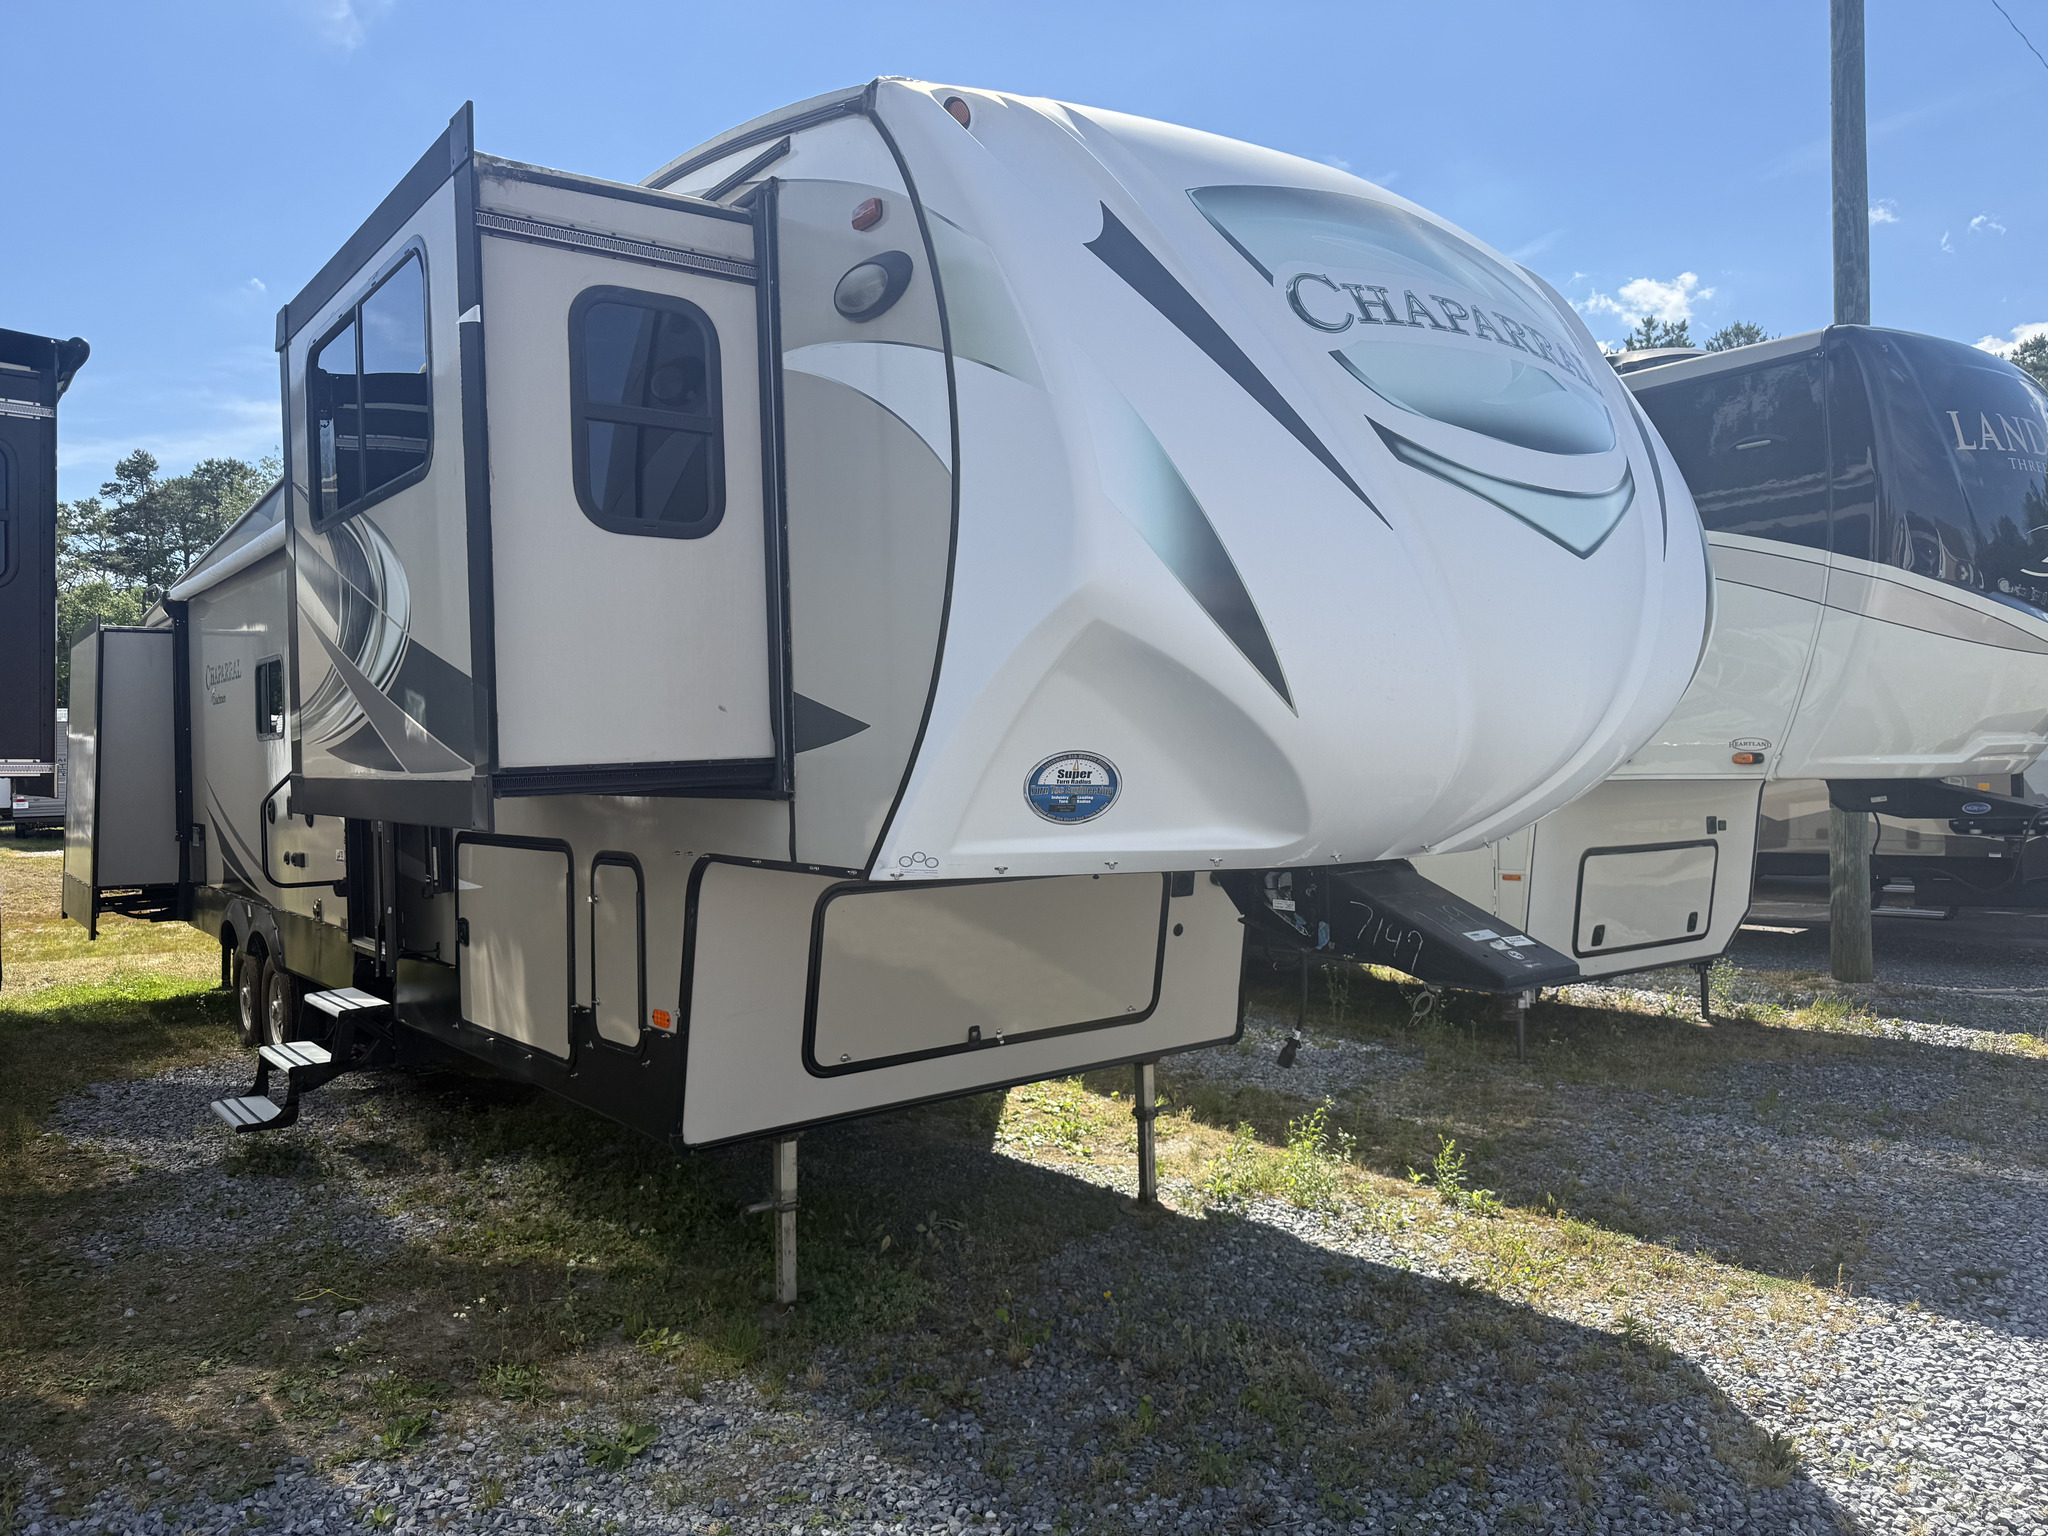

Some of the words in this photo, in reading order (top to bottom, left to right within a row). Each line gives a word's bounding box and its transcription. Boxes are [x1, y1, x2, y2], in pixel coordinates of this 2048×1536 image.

[1286, 272, 1604, 398] CHAPARRAL
[205, 659, 242, 690] CHAPARRAL
[1057, 769, 1092, 779] Super
[1030, 785, 1049, 796] Turn
